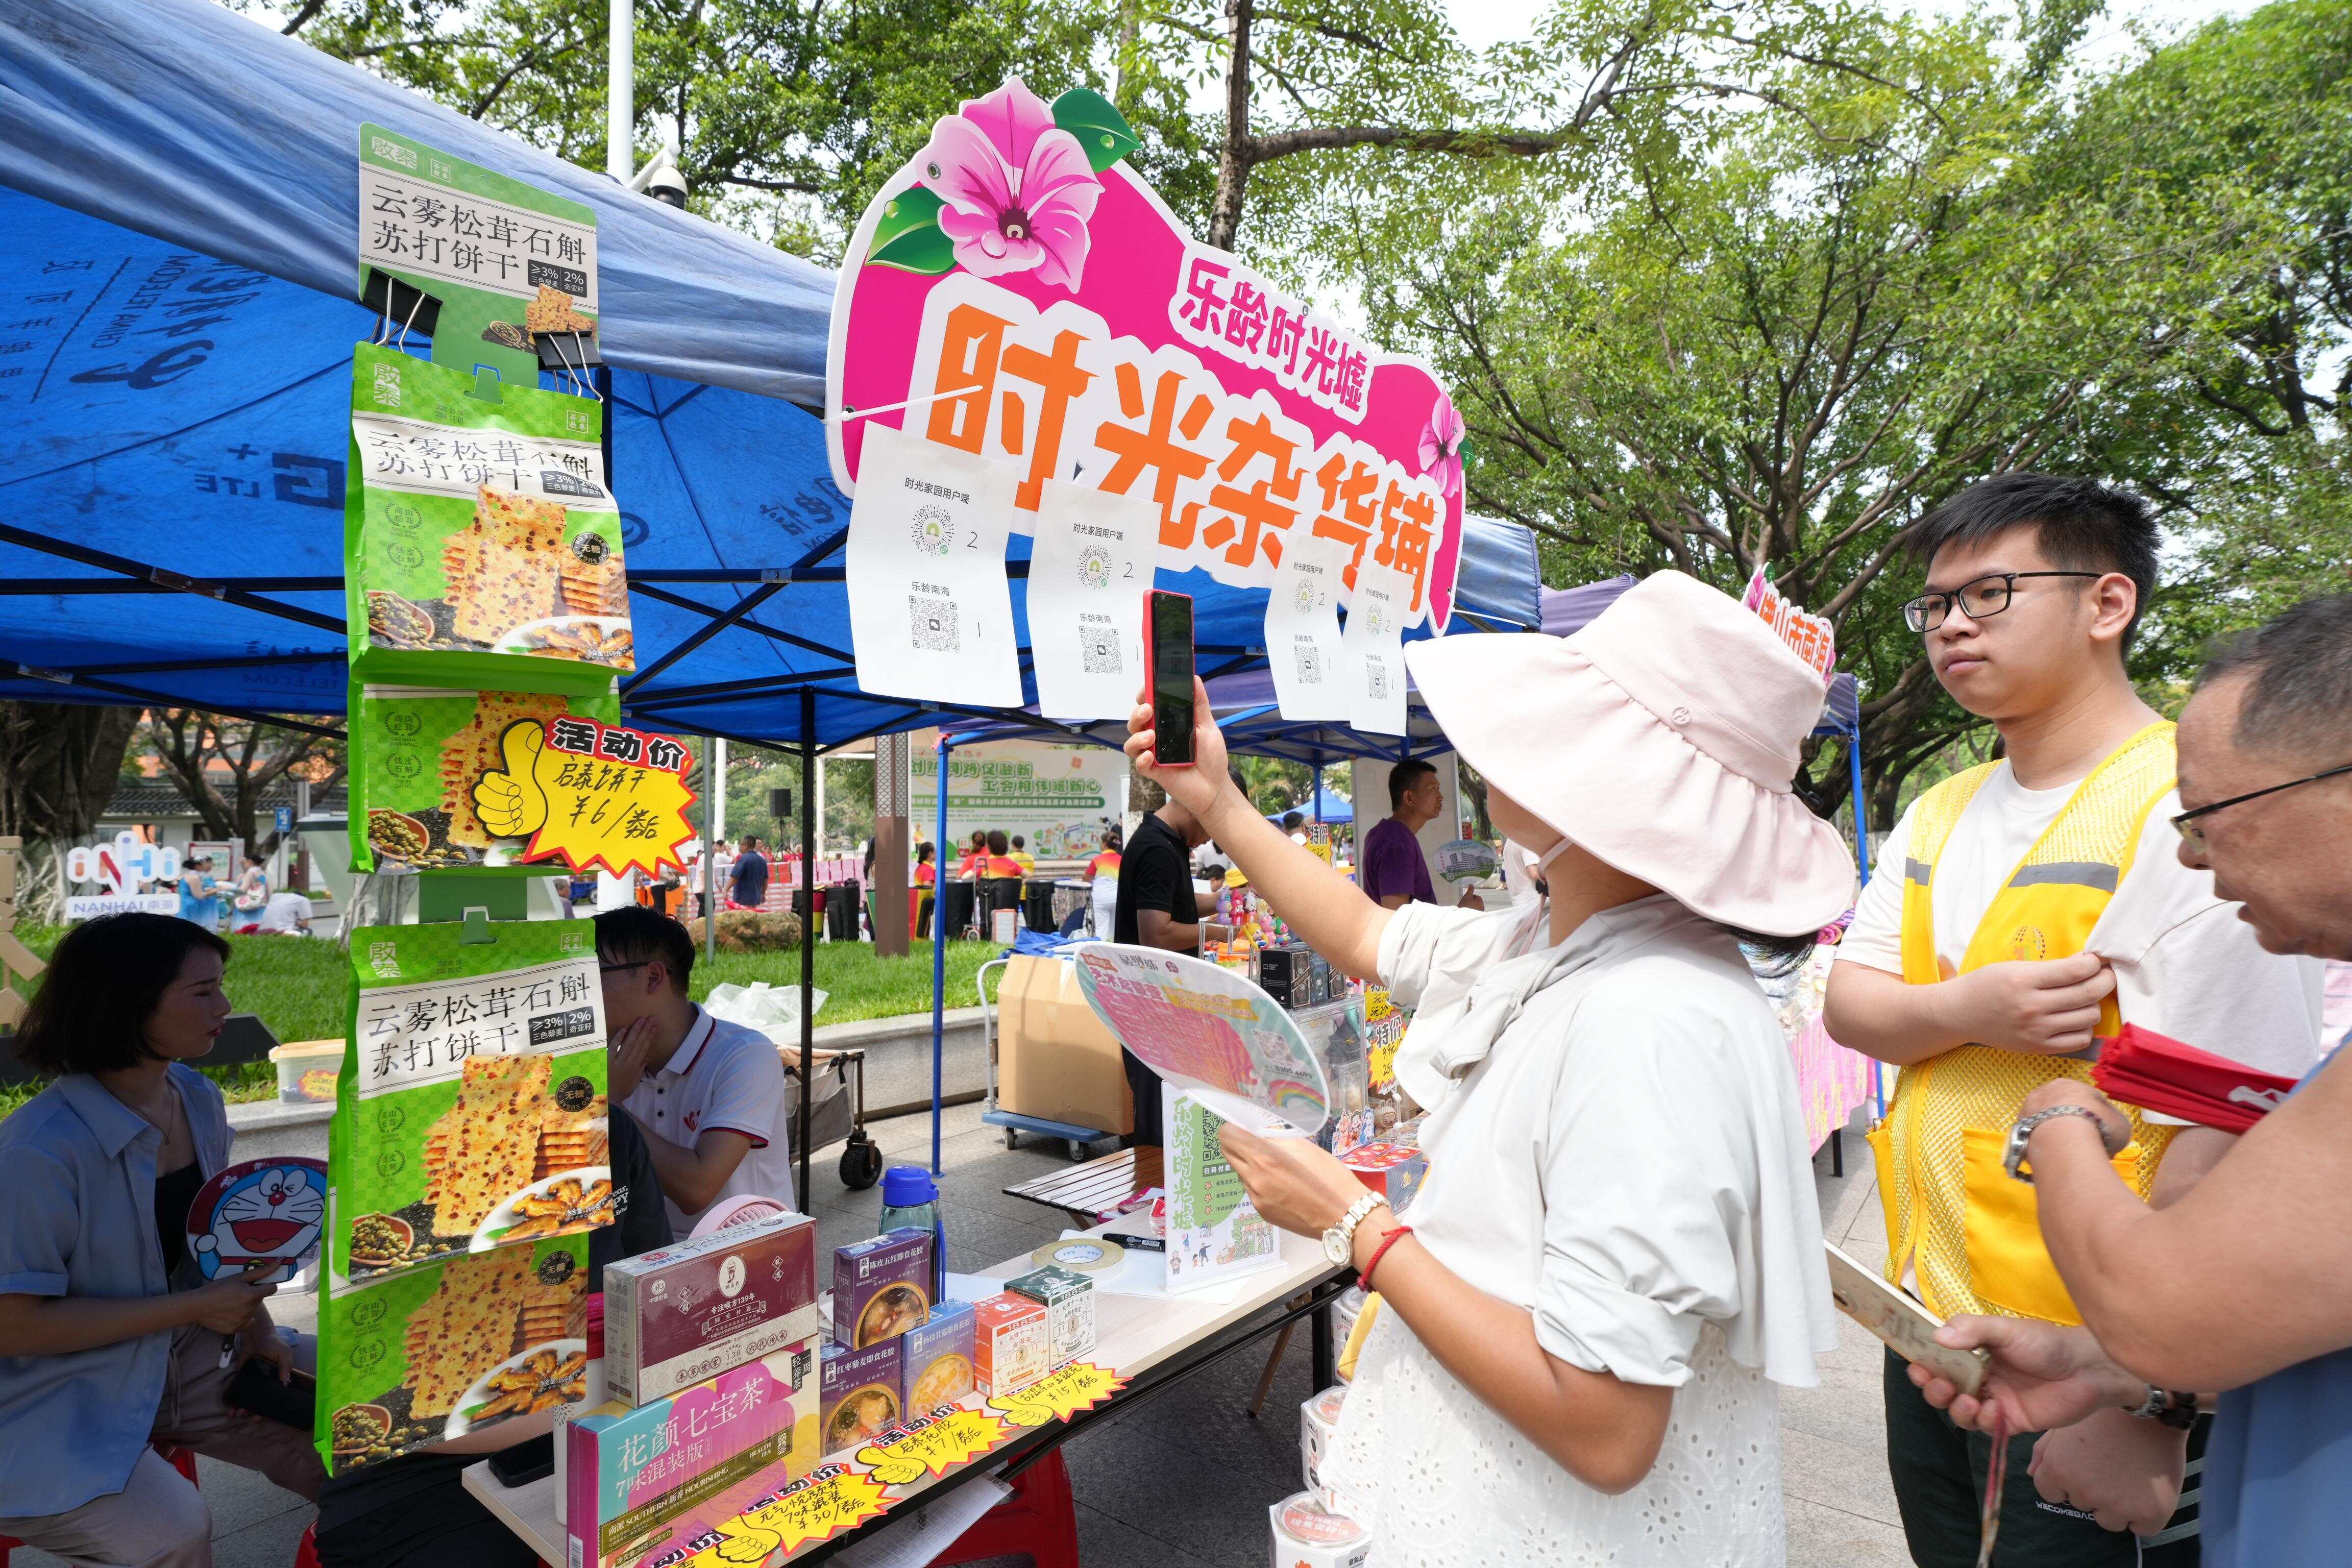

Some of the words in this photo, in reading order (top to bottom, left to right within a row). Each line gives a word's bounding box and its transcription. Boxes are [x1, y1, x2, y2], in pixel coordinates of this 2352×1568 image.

[373, 184, 586, 264] 云雾松茸石斛
[373, 220, 519, 279] 苏打饼干
[564, 272, 583, 285] 2%
[1178, 255, 1368, 415] 乐龄时光墟
[925, 303, 1439, 614] 时光杂货铺
[377, 452, 532, 490] 苏打饼干
[905, 477, 970, 504] 时光家园用户端
[967, 531, 977, 549] 2
[1073, 523, 1123, 541] 时光家园用户端
[581, 544, 601, 555] 无糖
[1123, 562, 1134, 578] 2
[1293, 562, 1323, 575] 时光家园用户端
[912, 581, 950, 596] 乐龄南海
[1318, 593, 1325, 605] 2
[1080, 613, 1112, 624] 乐龄南海
[1385, 620, 1390, 632] 2
[1294, 634, 1313, 643] 乐龄南海
[394, 713, 414, 723] 高山
[394, 723, 414, 732] 松茸
[552, 717, 686, 772] 活动价
[394, 756, 414, 765] 铁皮
[394, 765, 414, 774] 石斛
[983, 779, 1099, 794] 工会相伴暖新心
[1310, 825, 1327, 844] 特价
[74, 901, 143, 913] NANHAI
[368, 972, 591, 1038] 云雾松茸石斛
[569, 1011, 592, 1025] 2%
[533, 1028, 564, 1041] 三色藜麦
[569, 1022, 592, 1035] 奇亚籽
[1377, 1015, 1402, 1048] 特价
[371, 1023, 519, 1080] 苏打饼干
[559, 1084, 568, 1092] NO
[569, 1079, 590, 1090] SUGAR
[559, 1098, 580, 1110] SUGAR
[565, 1090, 584, 1100] 无糖
[1172, 1095, 1195, 1231] 乐龄时光墟
[1204, 1164, 1231, 1175] 扫码付款
[552, 1254, 571, 1263] SUGAR
[870, 1246, 923, 1270] 陈皮五红即食花胶
[547, 1263, 566, 1275] 无糖
[1060, 1286, 1085, 1300] 1885
[1007, 1316, 1037, 1331] 1885
[747, 1330, 787, 1355] 六代传承
[837, 1347, 895, 1374] 红枣藜麦即食花胶
[792, 1355, 802, 1391] 轻养茶
[618, 1378, 764, 1473] 花颜七宝茶
[874, 1404, 958, 1447] 活动价
[899, 1419, 959, 1454] 启泰花胶
[749, 1441, 771, 1459] HEALTH
[761, 1449, 771, 1458] TEA
[616, 1441, 703, 1498] 7味混装版
[626, 1499, 668, 1526] SOUTHERN
[685, 1466, 729, 1493] NOURISHING
[2036, 1501, 2095, 1521] WECOMEBAC
